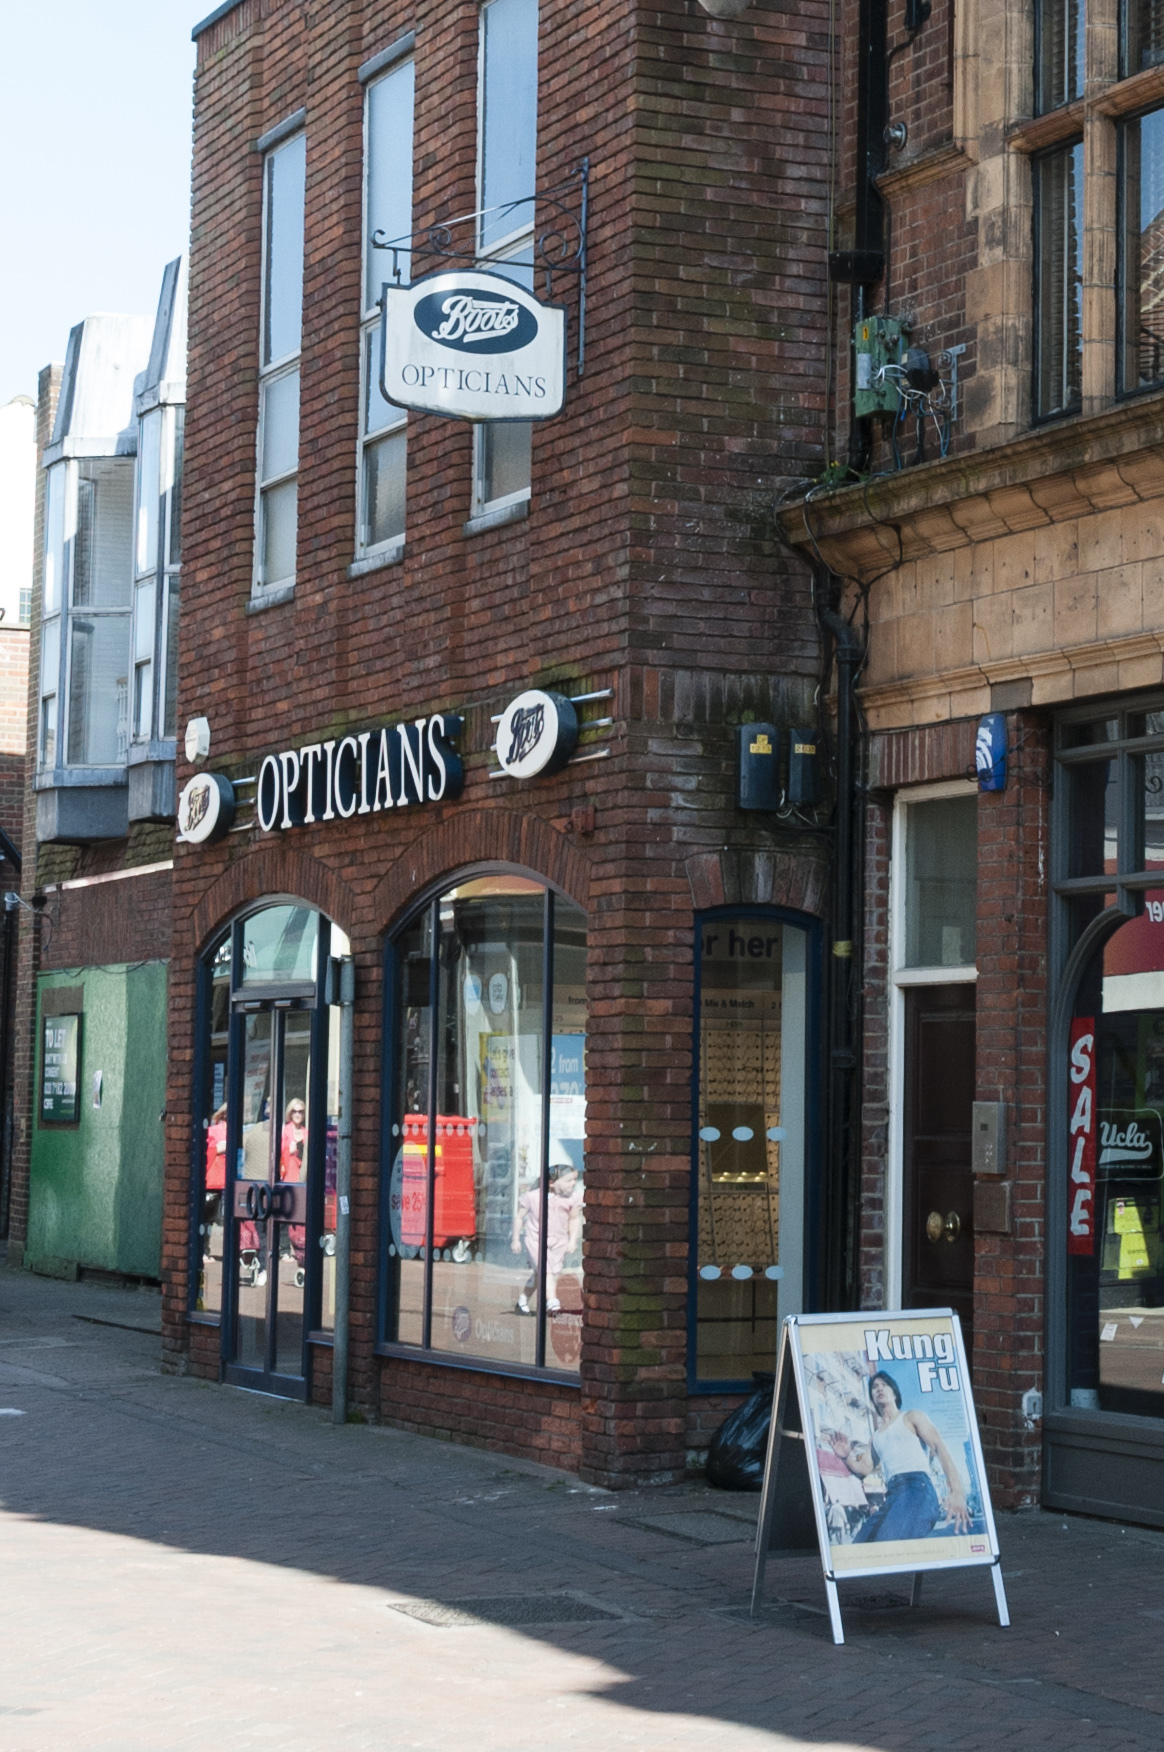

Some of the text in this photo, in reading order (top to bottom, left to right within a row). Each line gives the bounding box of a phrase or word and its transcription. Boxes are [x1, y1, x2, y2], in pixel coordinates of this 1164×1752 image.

[431, 295, 519, 343] Boots
[401, 364, 547, 399] OPTICIANS
[505, 703, 546, 766] Boots
[257, 714, 452, 832] OPTICIANS
[729, 929, 778, 958] her
[705, 999, 719, 1008] Mix
[729, 999, 755, 1009] Match
[45, 1028, 67, 1048] TO LET
[558, 1053, 579, 1074] from
[1070, 1034, 1094, 1236] SALE
[1100, 1121, 1152, 1147] Ucla
[864, 1329, 956, 1364] Kung
[917, 1361, 960, 1393] Fu
